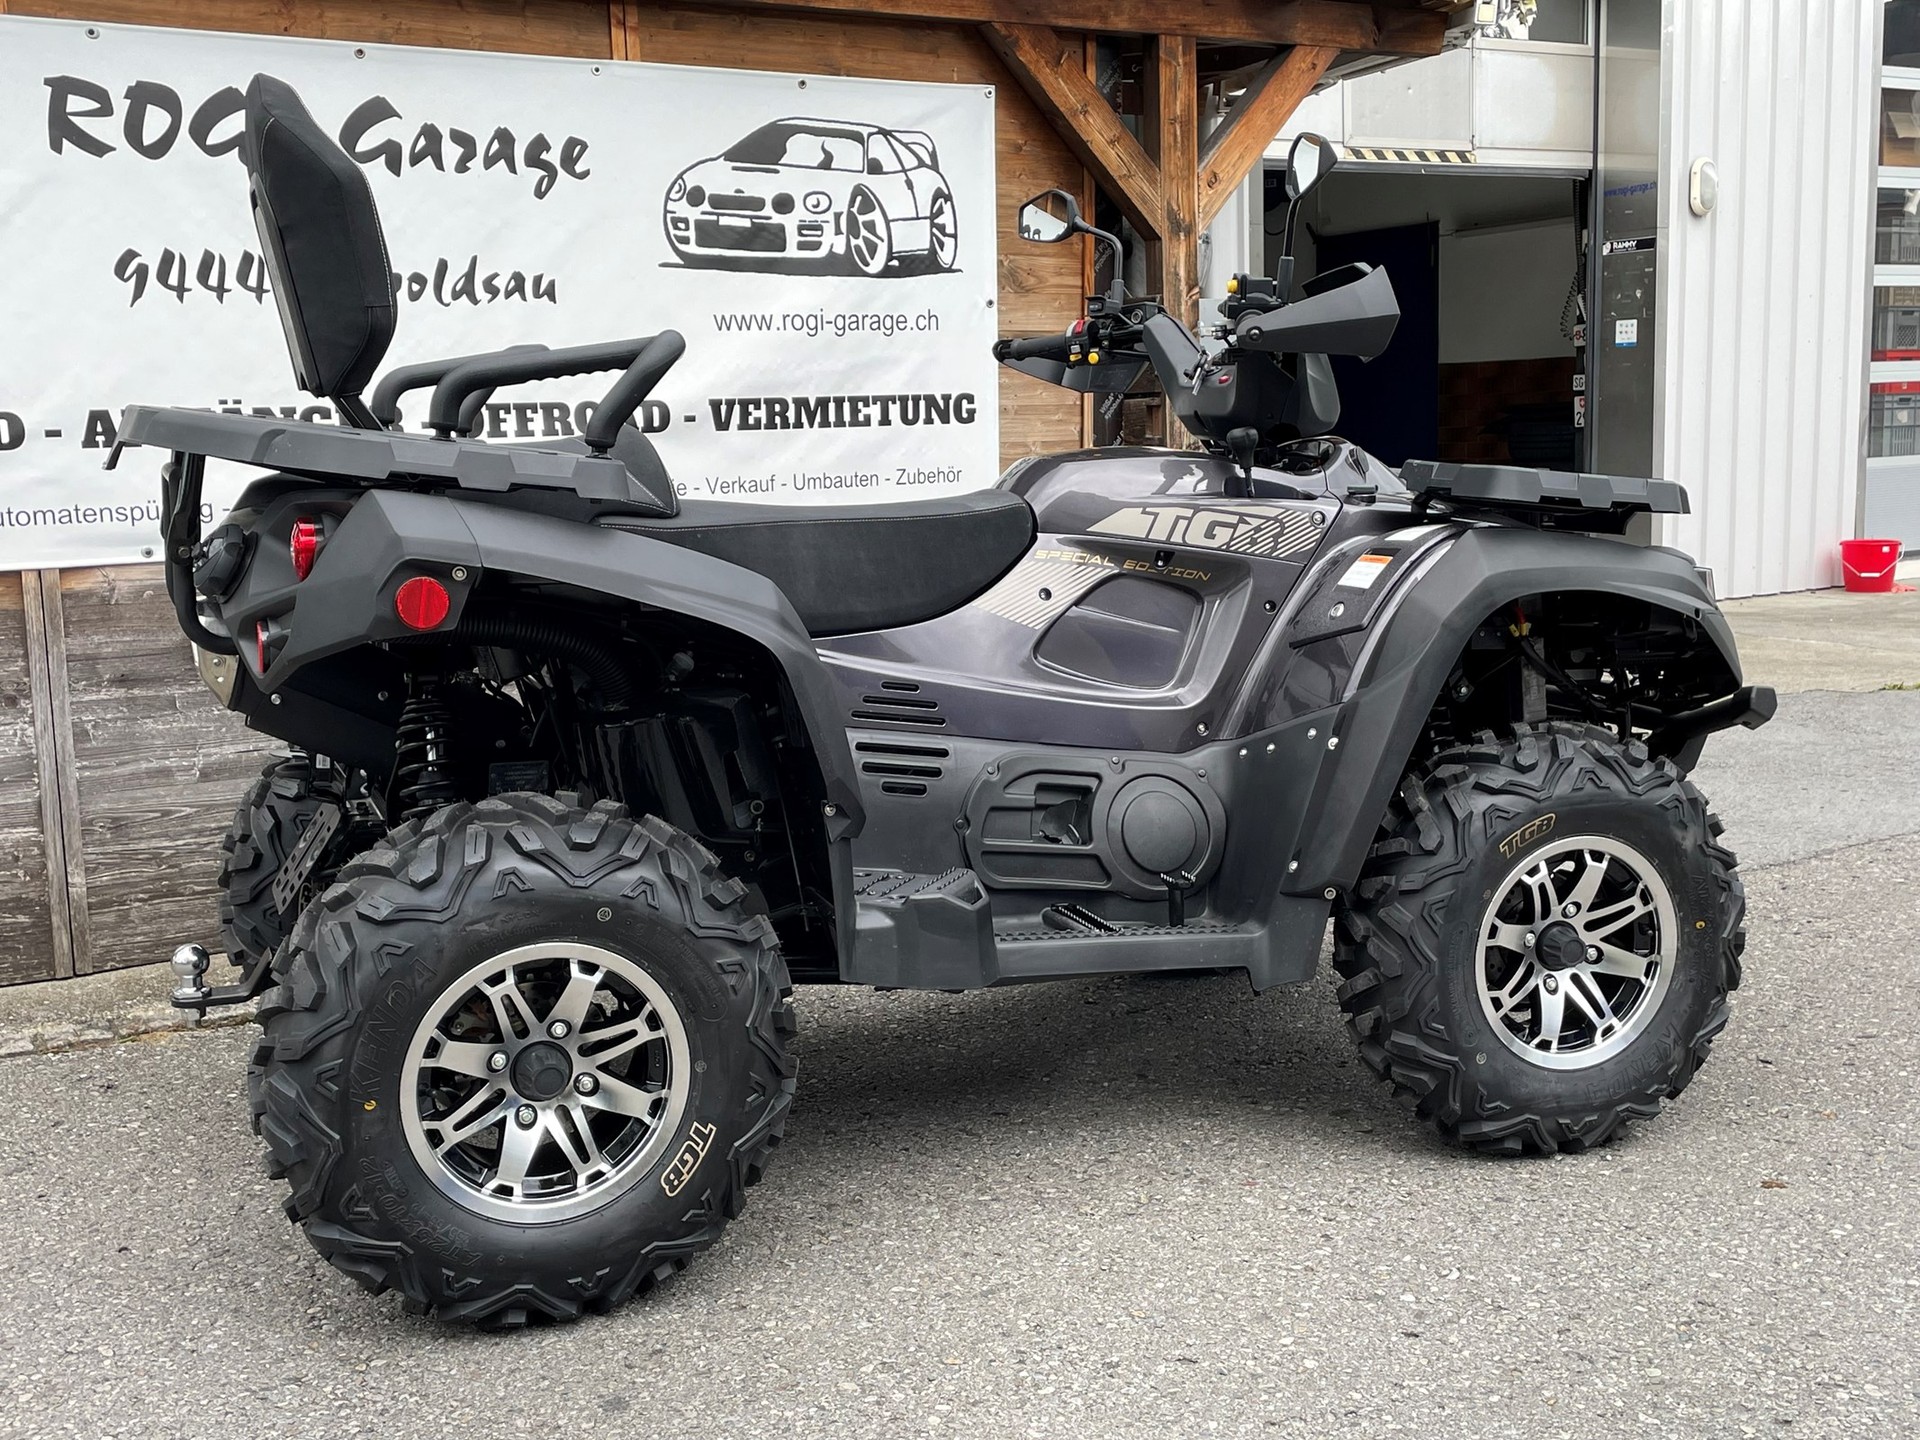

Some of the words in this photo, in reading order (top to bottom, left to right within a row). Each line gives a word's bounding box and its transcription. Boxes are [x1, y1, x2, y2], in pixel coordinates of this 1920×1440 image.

[43, 75, 248, 166] ROG
[338, 95, 591, 200] Garage
[114, 247, 271, 308] 9444
[391, 254, 558, 308] oldsau
[713, 308, 940, 338] www.rogi-garage.ch
[709, 393, 978, 432] VERMIETUNG
[705, 474, 776, 496] Verkauf
[793, 471, 879, 492] Umbauten
[895, 466, 963, 486] Zubehör
[1033, 549, 1115, 567] SPECIAL
[1499, 812, 1556, 860] TGB
[660, 1121, 717, 1197] TGB
